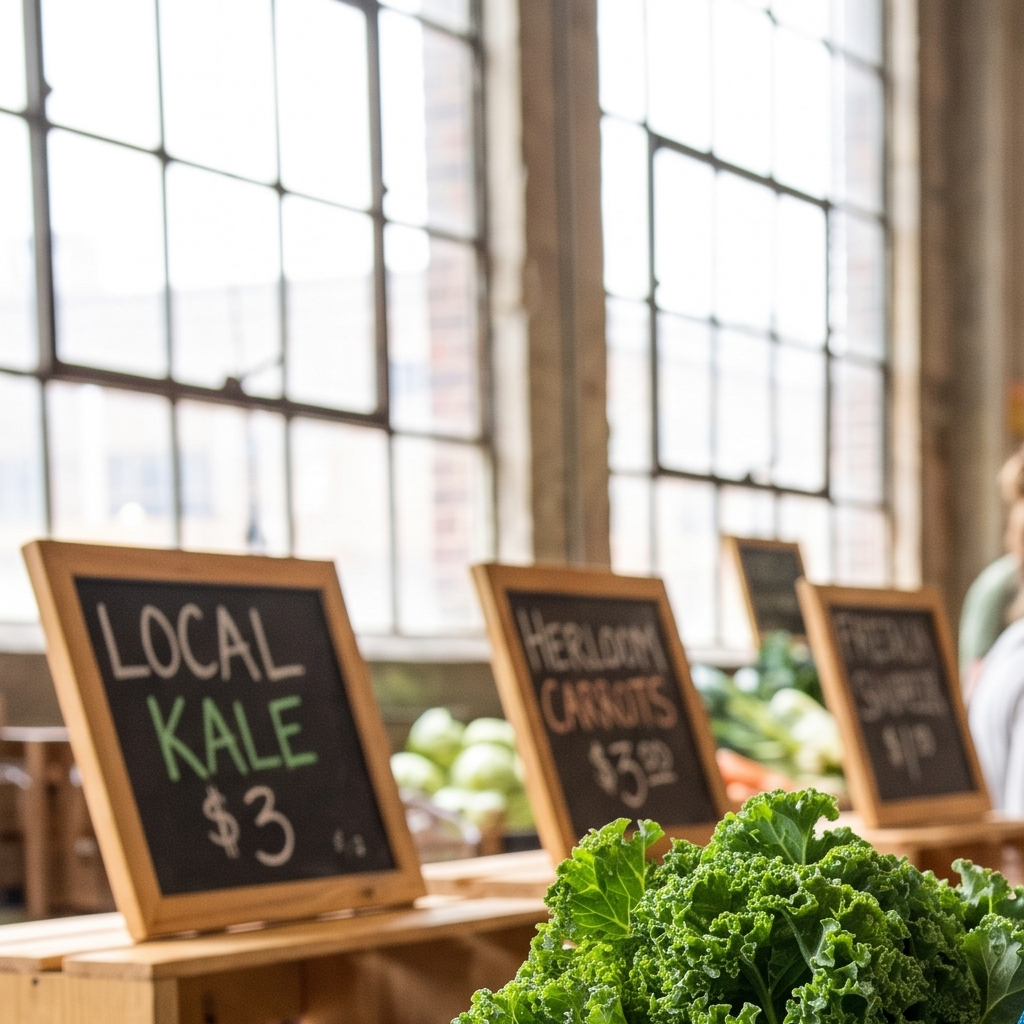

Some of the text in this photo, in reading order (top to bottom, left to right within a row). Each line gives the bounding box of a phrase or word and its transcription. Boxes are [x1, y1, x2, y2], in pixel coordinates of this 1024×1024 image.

[97, 602, 305, 681] LOCAL
[147, 694, 318, 782] KALE
[203, 785, 295, 866] $3
